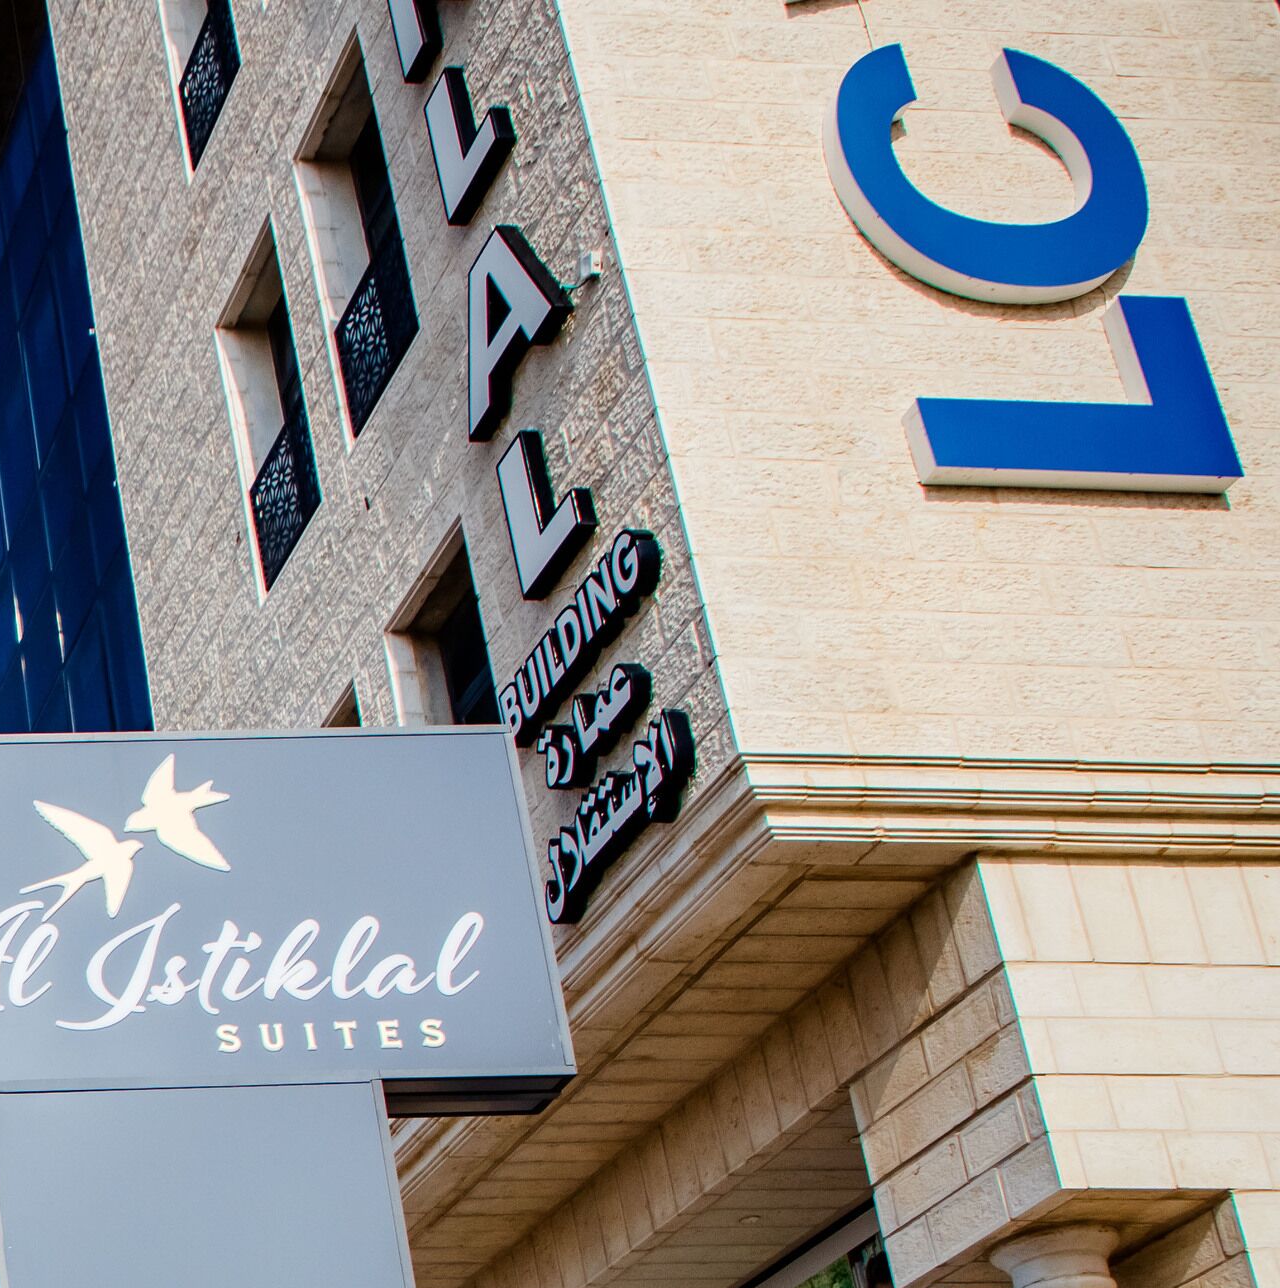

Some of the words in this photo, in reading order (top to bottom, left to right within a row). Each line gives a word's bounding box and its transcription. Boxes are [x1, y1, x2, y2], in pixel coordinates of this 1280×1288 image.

[822, 42, 1245, 495] LC
[500, 528, 658, 746] BUILDING
[537, 663, 653, 789] عمارة
[55, 903, 485, 1032] Istiklal
[216, 1018, 446, 1054] SUITES
